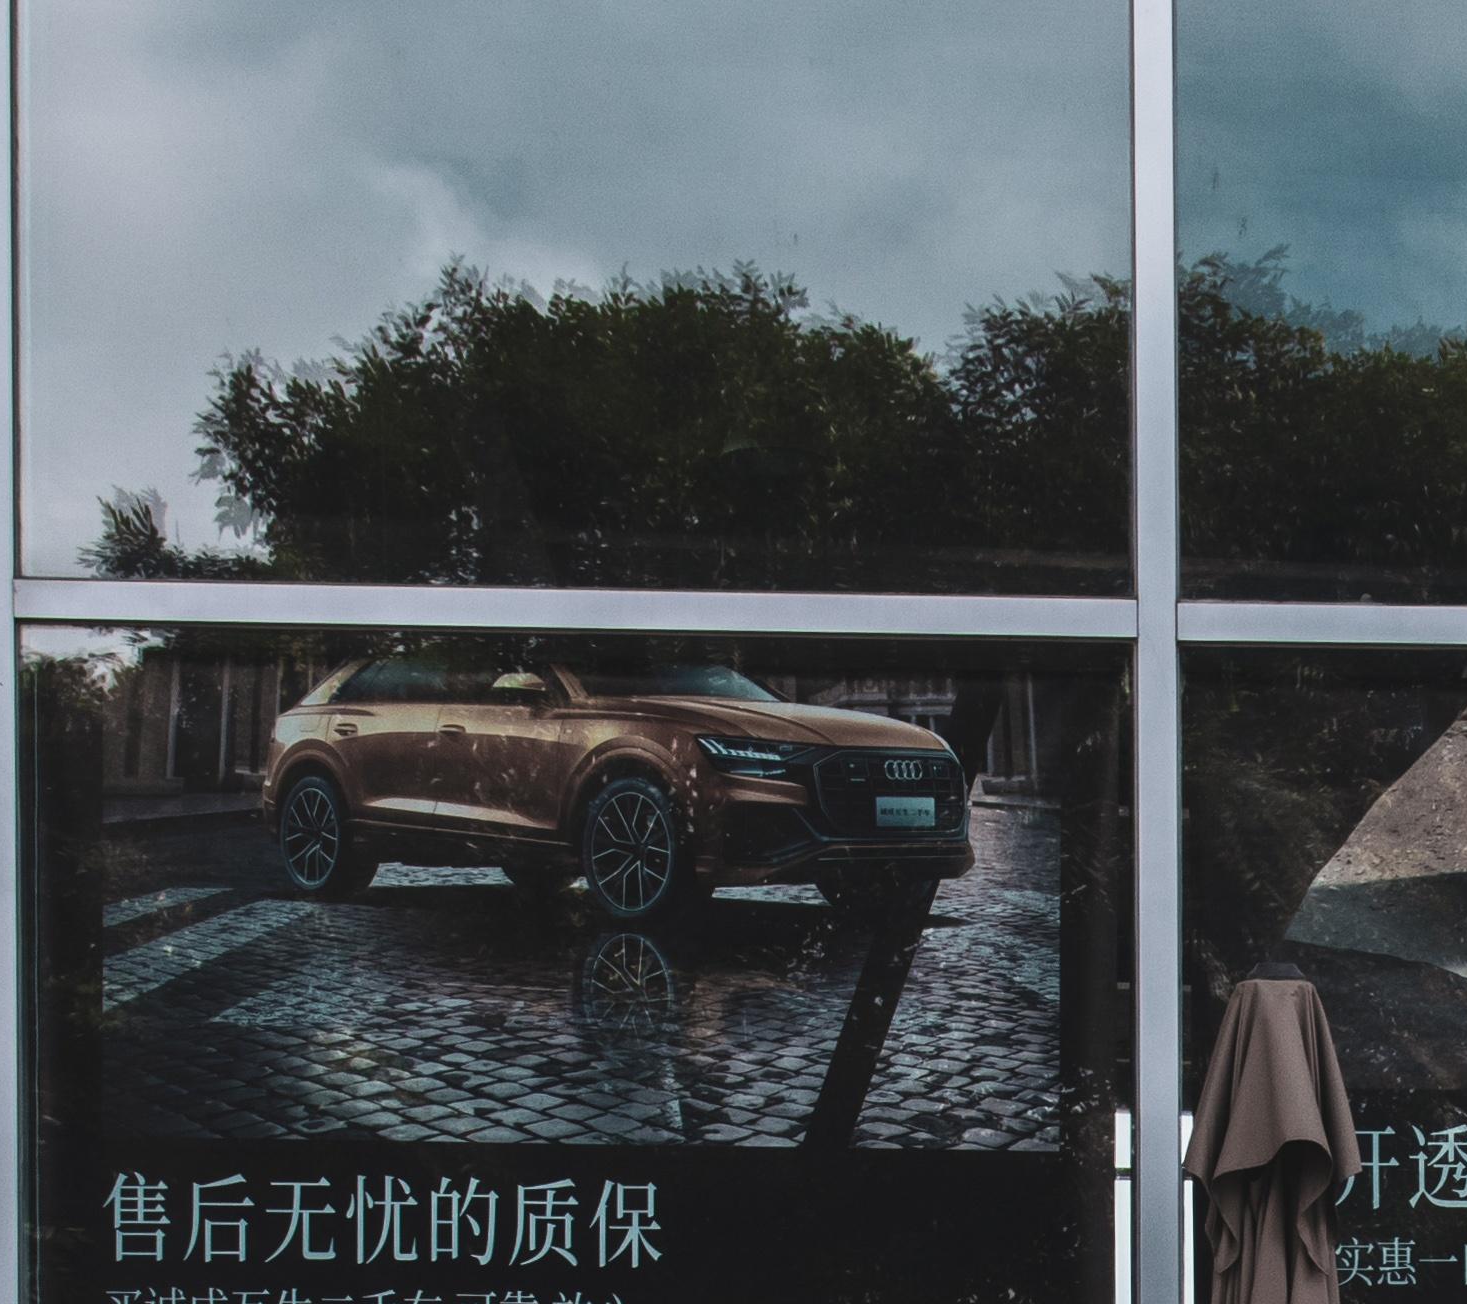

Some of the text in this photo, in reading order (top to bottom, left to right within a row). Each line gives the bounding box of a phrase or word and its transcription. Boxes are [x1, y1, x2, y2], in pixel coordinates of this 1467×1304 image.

[102, 1171, 664, 1269] 售后无忧的质保
